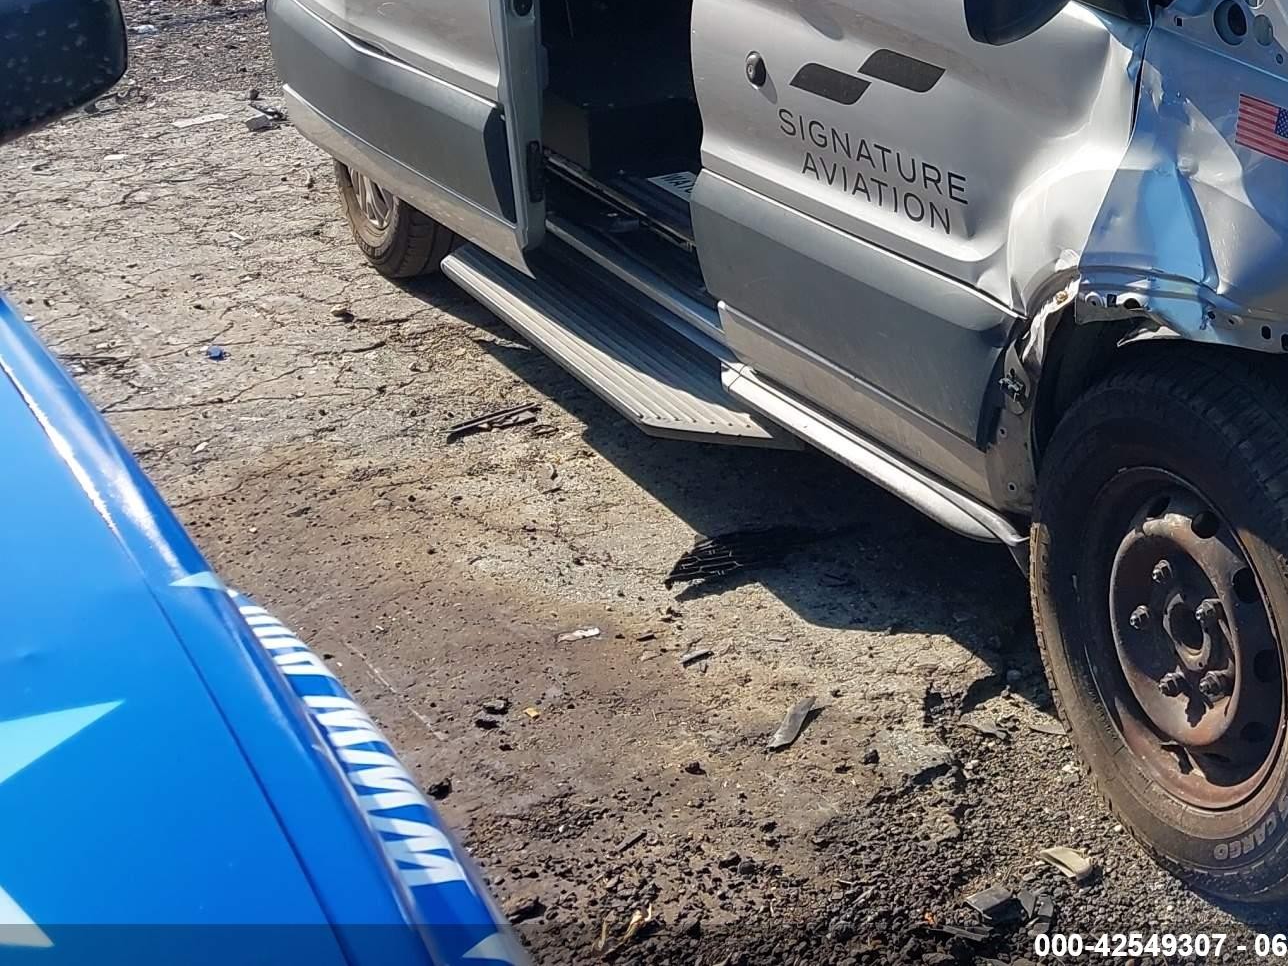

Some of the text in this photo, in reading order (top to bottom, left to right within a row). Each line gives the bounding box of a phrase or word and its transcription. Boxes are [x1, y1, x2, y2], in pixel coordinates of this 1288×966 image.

[778, 108, 969, 205] SIGNATURE
[801, 152, 951, 235] AVIATION
[1213, 811, 1278, 861] CARGO
